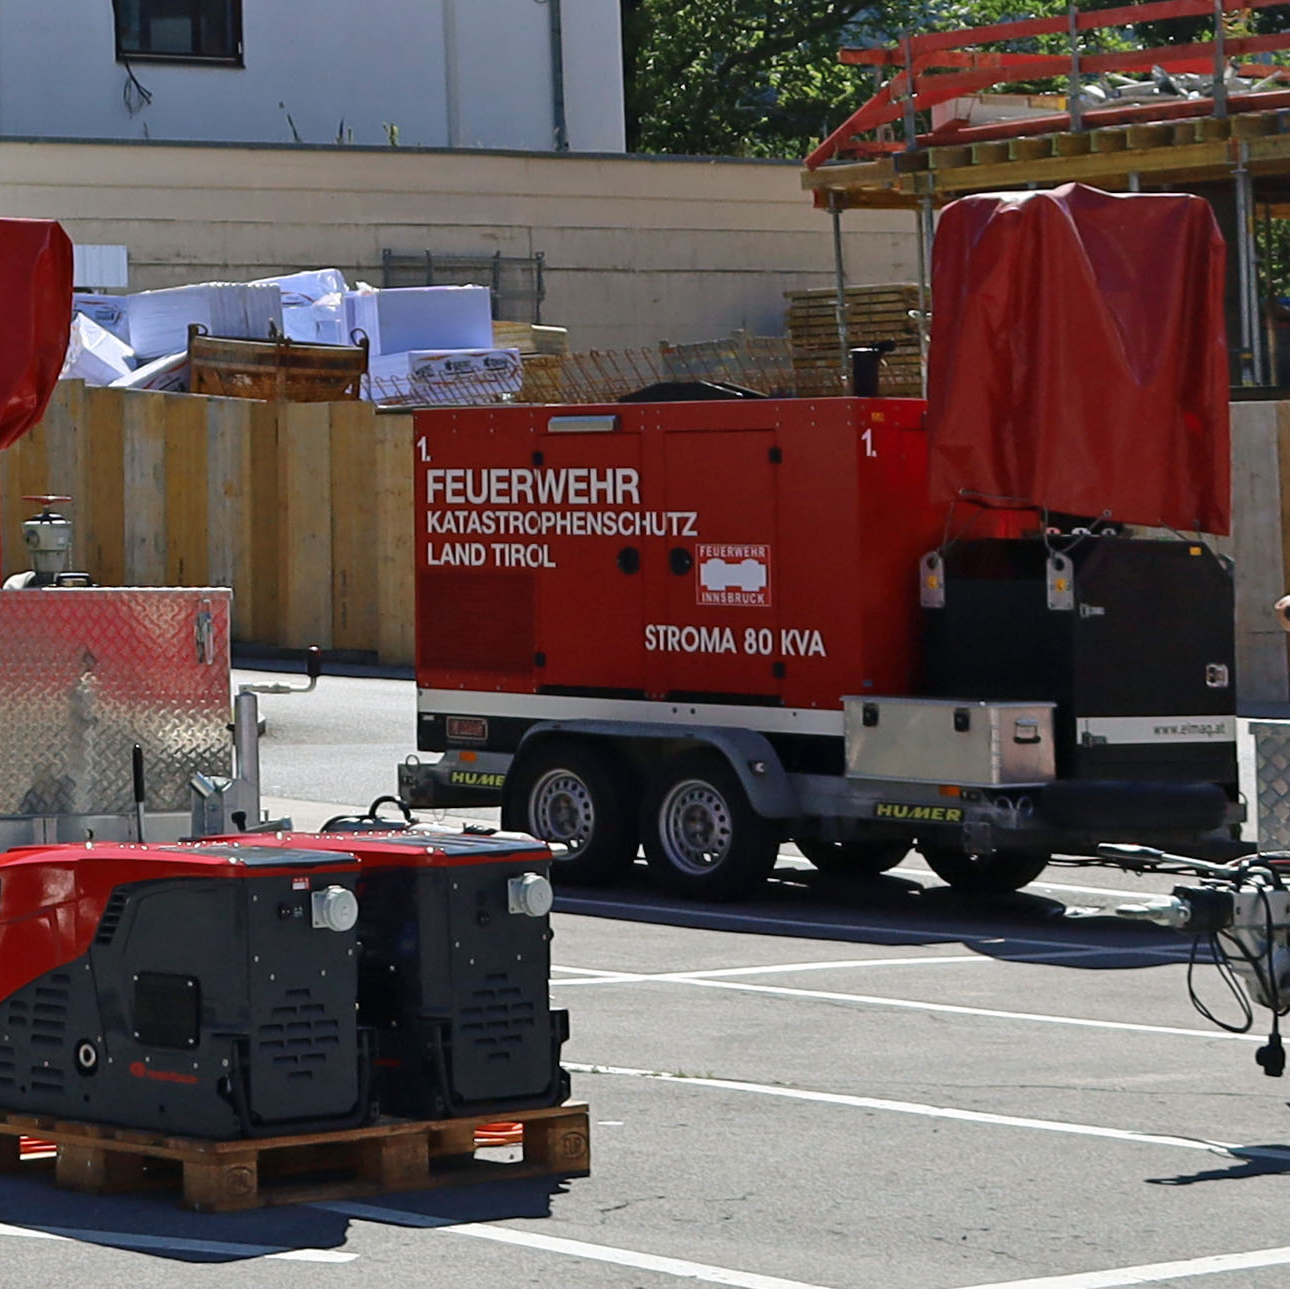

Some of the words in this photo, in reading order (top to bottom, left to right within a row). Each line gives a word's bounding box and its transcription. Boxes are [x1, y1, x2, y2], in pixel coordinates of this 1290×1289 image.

[418, 437, 430, 461] 1.
[862, 429, 876, 456] 1.
[428, 469, 639, 504] FEUERWEHR
[428, 511, 697, 536] KATASTROPHENSCHUTZ
[428, 543, 485, 565] LAND
[491, 544, 555, 567] TIROL
[700, 545, 765, 559] FEUERWEHR
[700, 591, 765, 604] INNSBRUCK
[646, 625, 736, 653] STROMA
[745, 628, 772, 654] 80
[782, 630, 825, 656] KVA
[453, 772, 506, 785] HUME
[878, 805, 960, 821] HUMER
